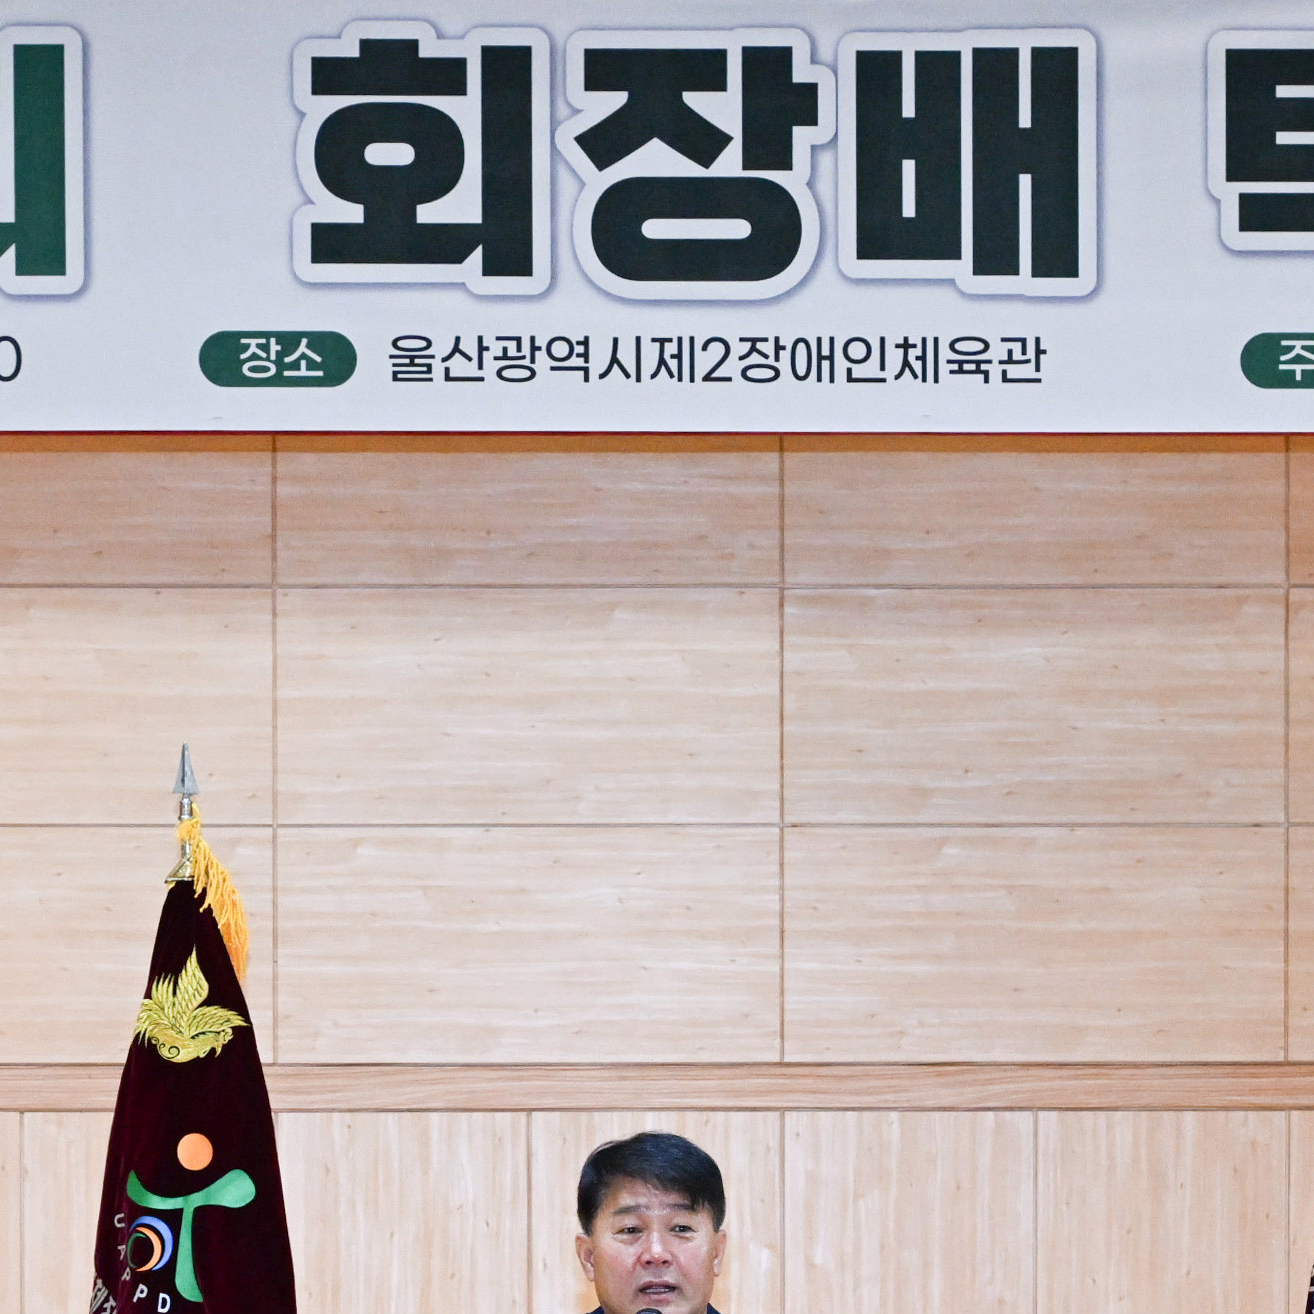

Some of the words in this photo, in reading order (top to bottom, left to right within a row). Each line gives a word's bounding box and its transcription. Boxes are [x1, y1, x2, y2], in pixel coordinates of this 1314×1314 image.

[309, 37, 1080, 281] 회장배
[238, 336, 324, 380] 장소
[387, 334, 1049, 385] 울산광역시제2장애인체육관
